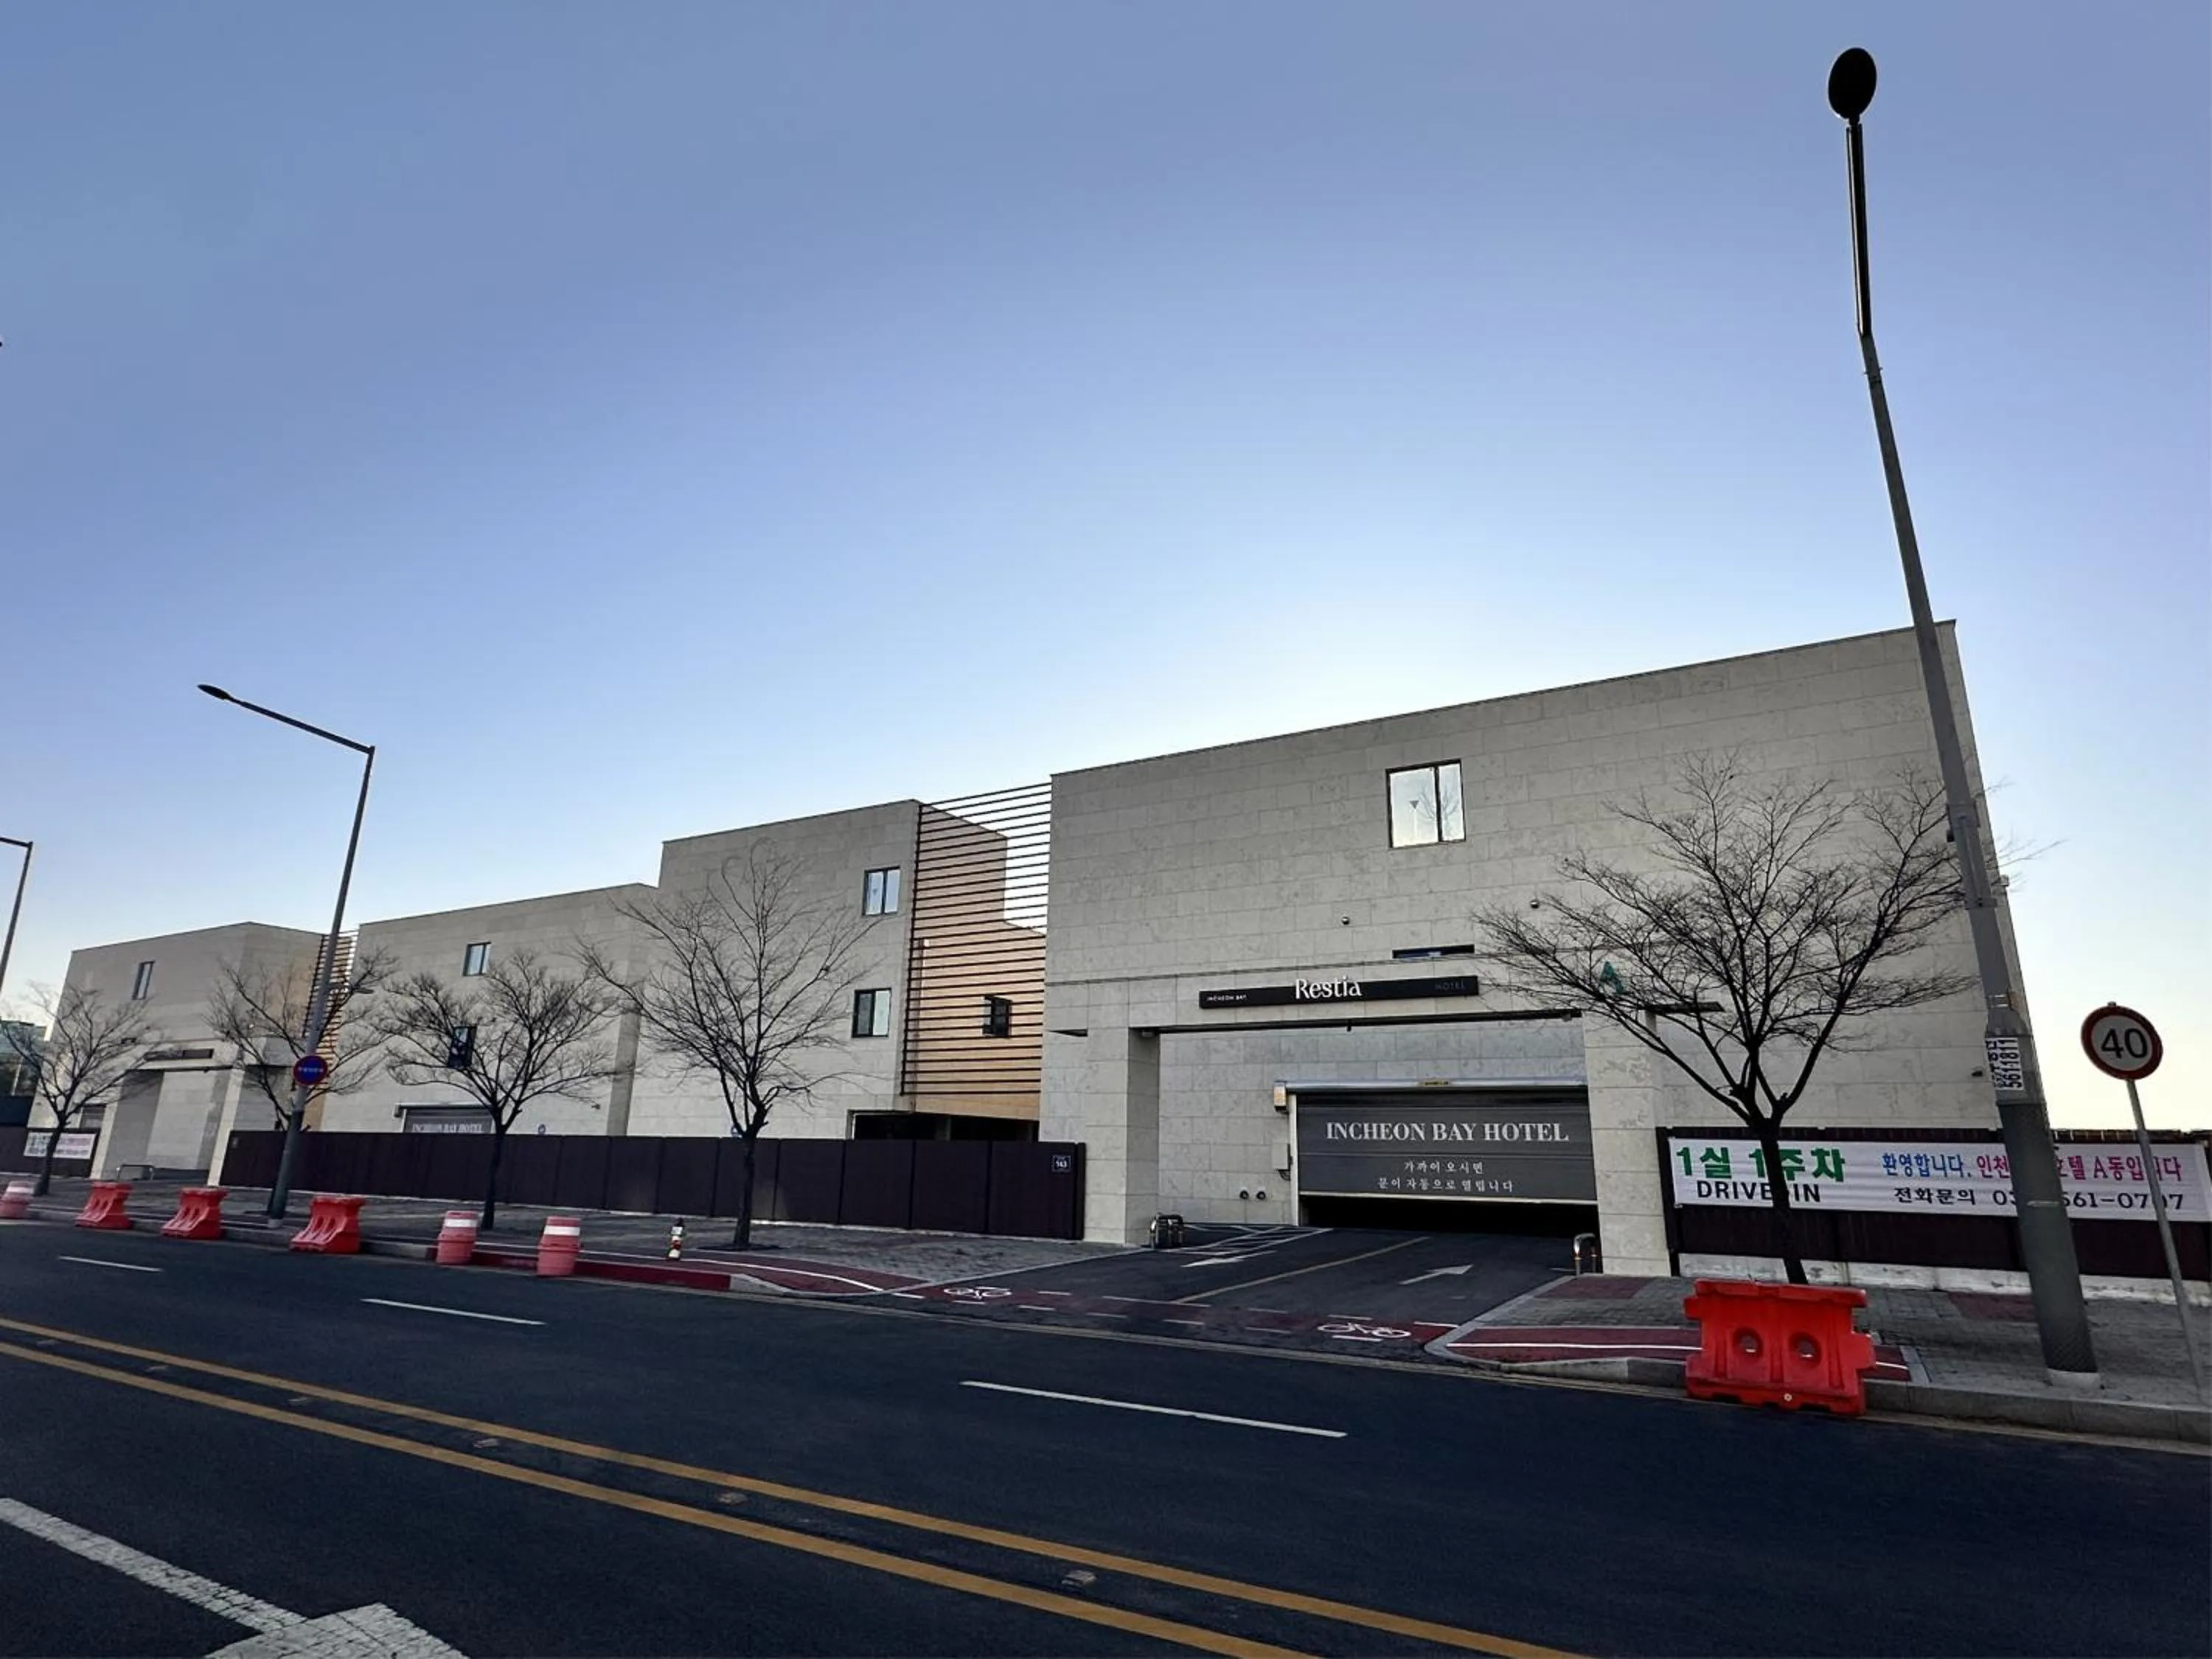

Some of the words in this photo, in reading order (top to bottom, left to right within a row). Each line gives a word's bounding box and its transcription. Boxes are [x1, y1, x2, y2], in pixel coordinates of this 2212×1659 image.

[1295, 975, 1362, 1000] Restia
[2100, 1028, 2148, 1060] 40
[1326, 1121, 1426, 1141] INCHEON
[1432, 1122, 1477, 1141] BAY
[1483, 1122, 1570, 1142] HOTEL
[1404, 1160, 1441, 1174] 가까이
[1445, 1161, 1484, 1175] 오시면
[1676, 1147, 1732, 1180] 1실
[1748, 1147, 1846, 1182] 1주차
[1882, 1152, 1972, 1178] 환영합니다.
[1377, 1177, 1400, 1189] 문이
[1406, 1178, 1457, 1191] 자동으로
[1893, 1186, 1977, 1206] 전화문의
